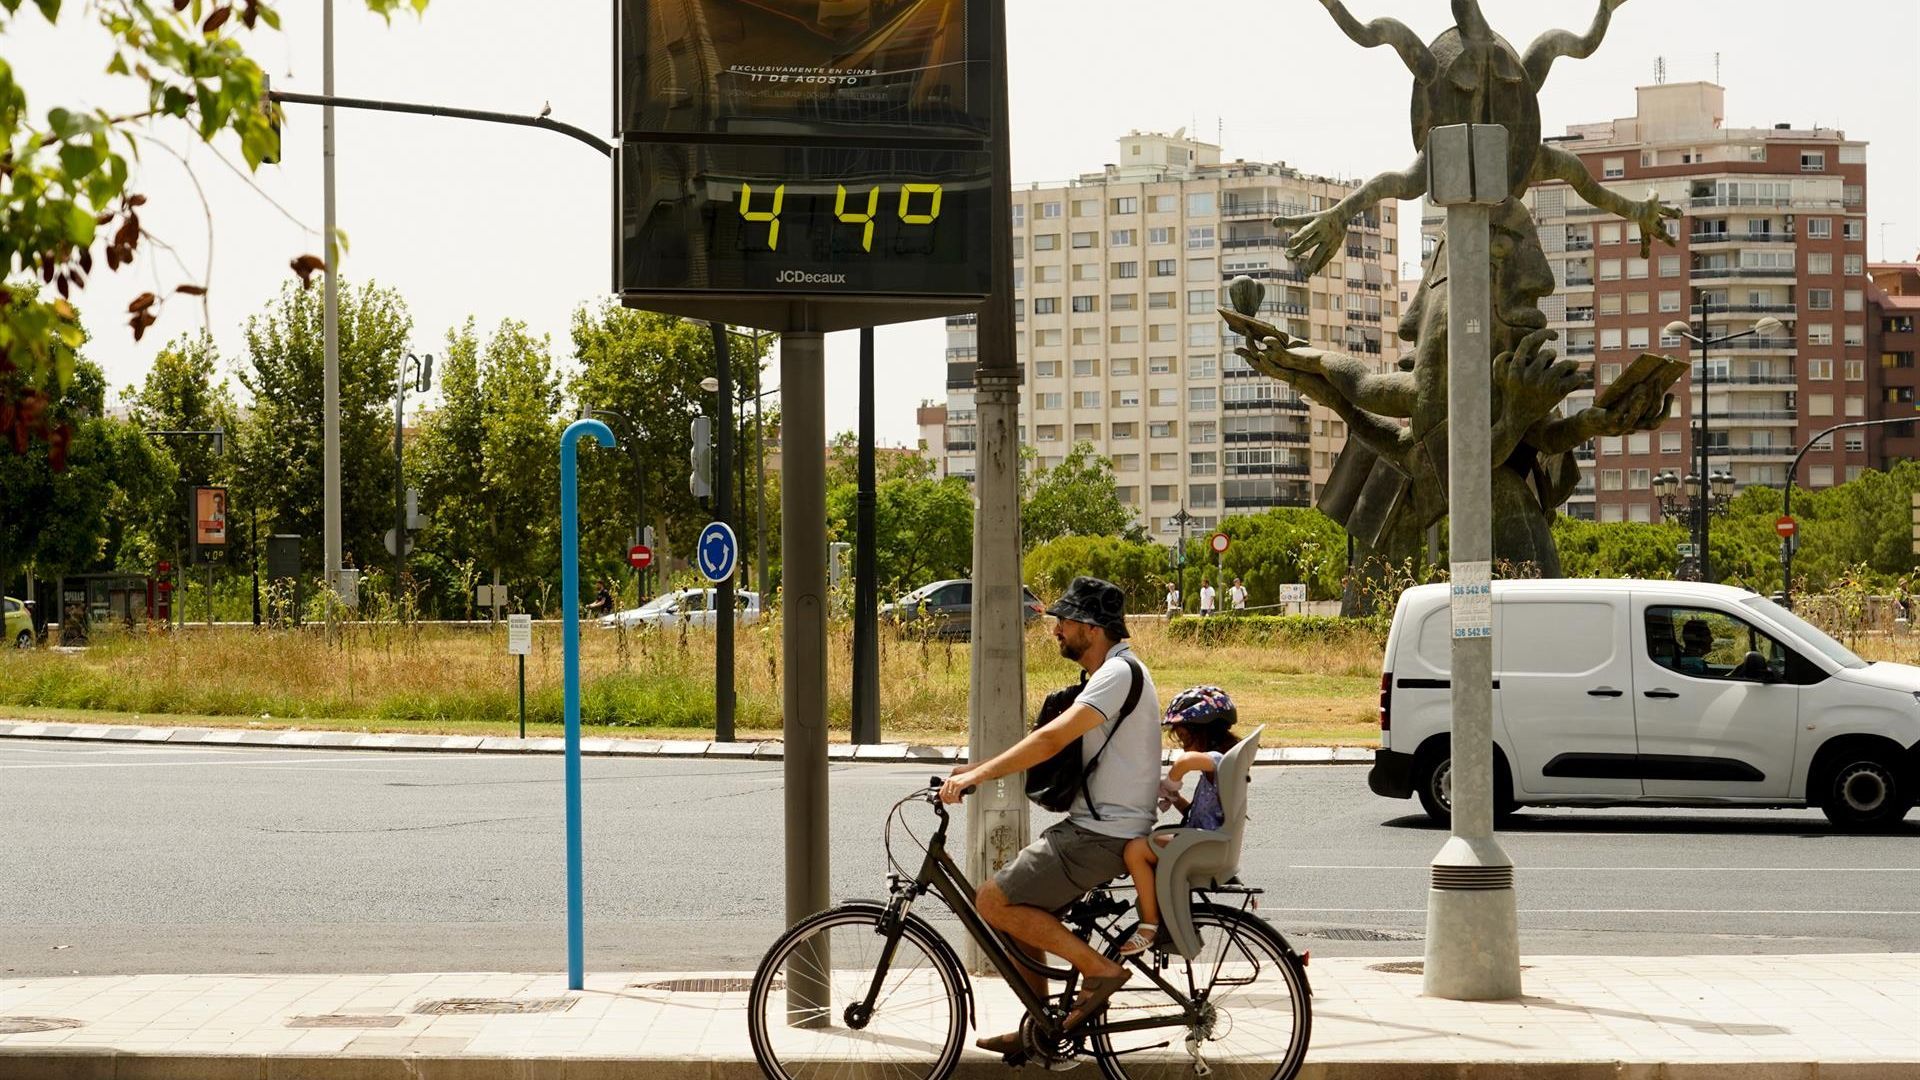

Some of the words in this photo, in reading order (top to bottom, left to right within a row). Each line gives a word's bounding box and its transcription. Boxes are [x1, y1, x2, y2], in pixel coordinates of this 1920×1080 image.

[730, 65, 824, 74] EXCLUSIVAMENTE
[751, 74, 762, 82] 11
[769, 75, 789, 83] DE
[795, 76, 857, 85] AGOSTO
[776, 270, 845, 284] JCDecaux
